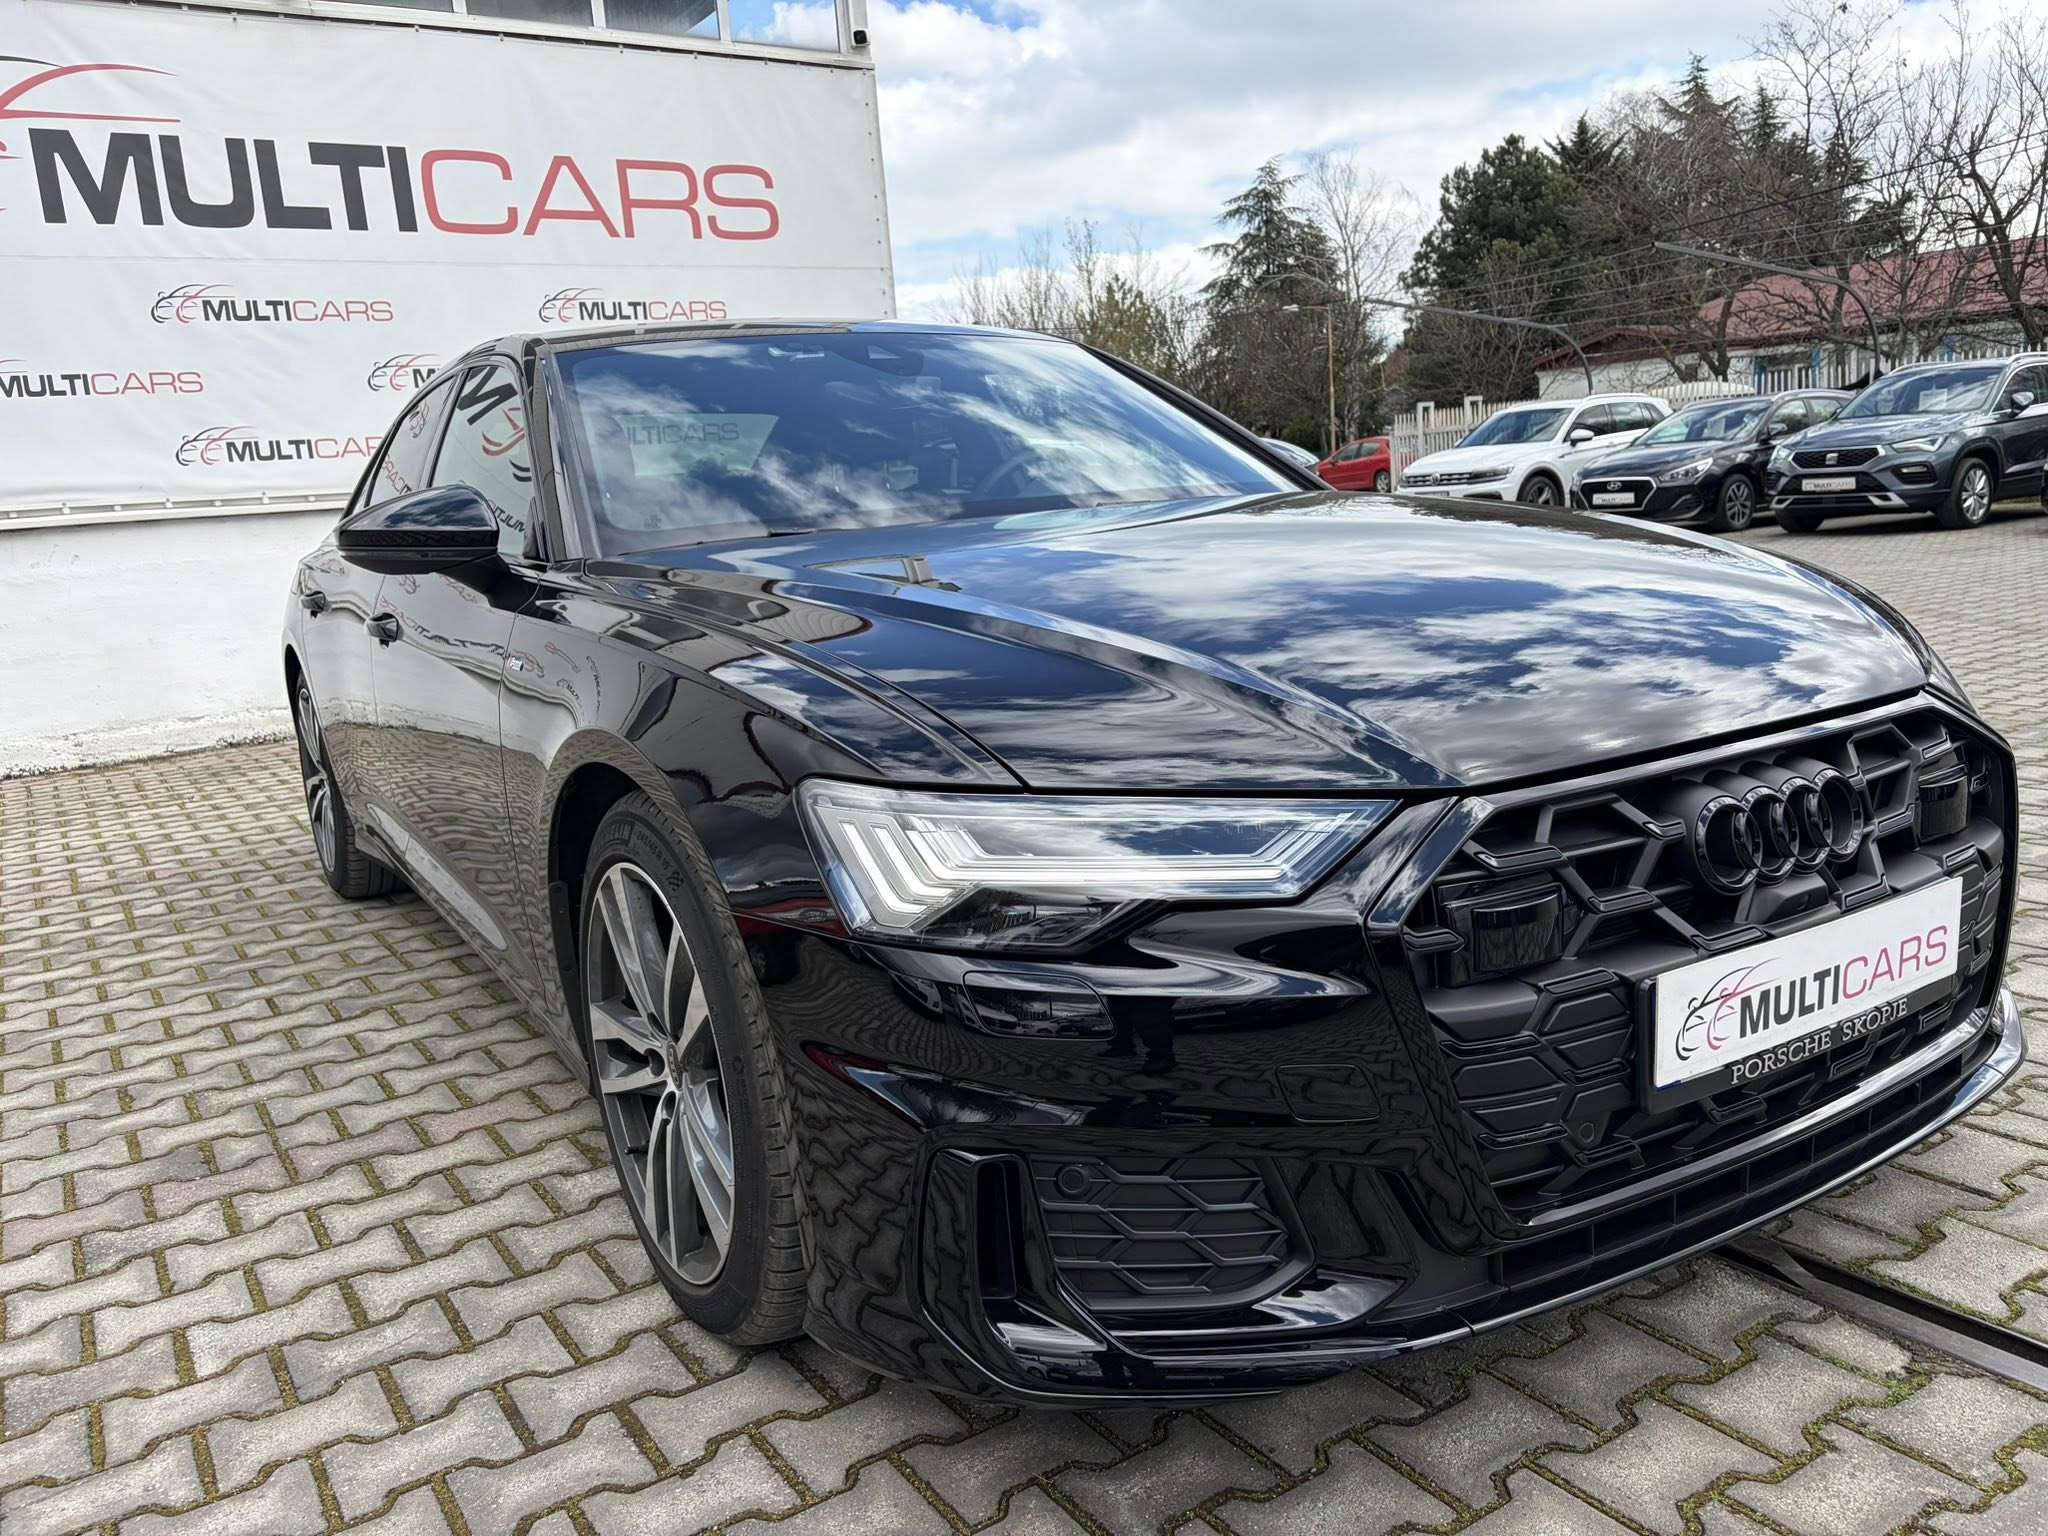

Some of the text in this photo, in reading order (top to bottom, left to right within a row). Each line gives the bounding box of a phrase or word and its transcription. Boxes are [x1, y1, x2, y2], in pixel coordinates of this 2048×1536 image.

[28, 127, 780, 241] MULTICARS
[202, 299, 394, 322] MULTICARS
[579, 300, 727, 321] MULTICARS
[0, 371, 204, 398] MULTICARS
[1738, 924, 1949, 1038] MULTICARS
[1730, 997, 1908, 1085] PORSCHE SKOPJE
